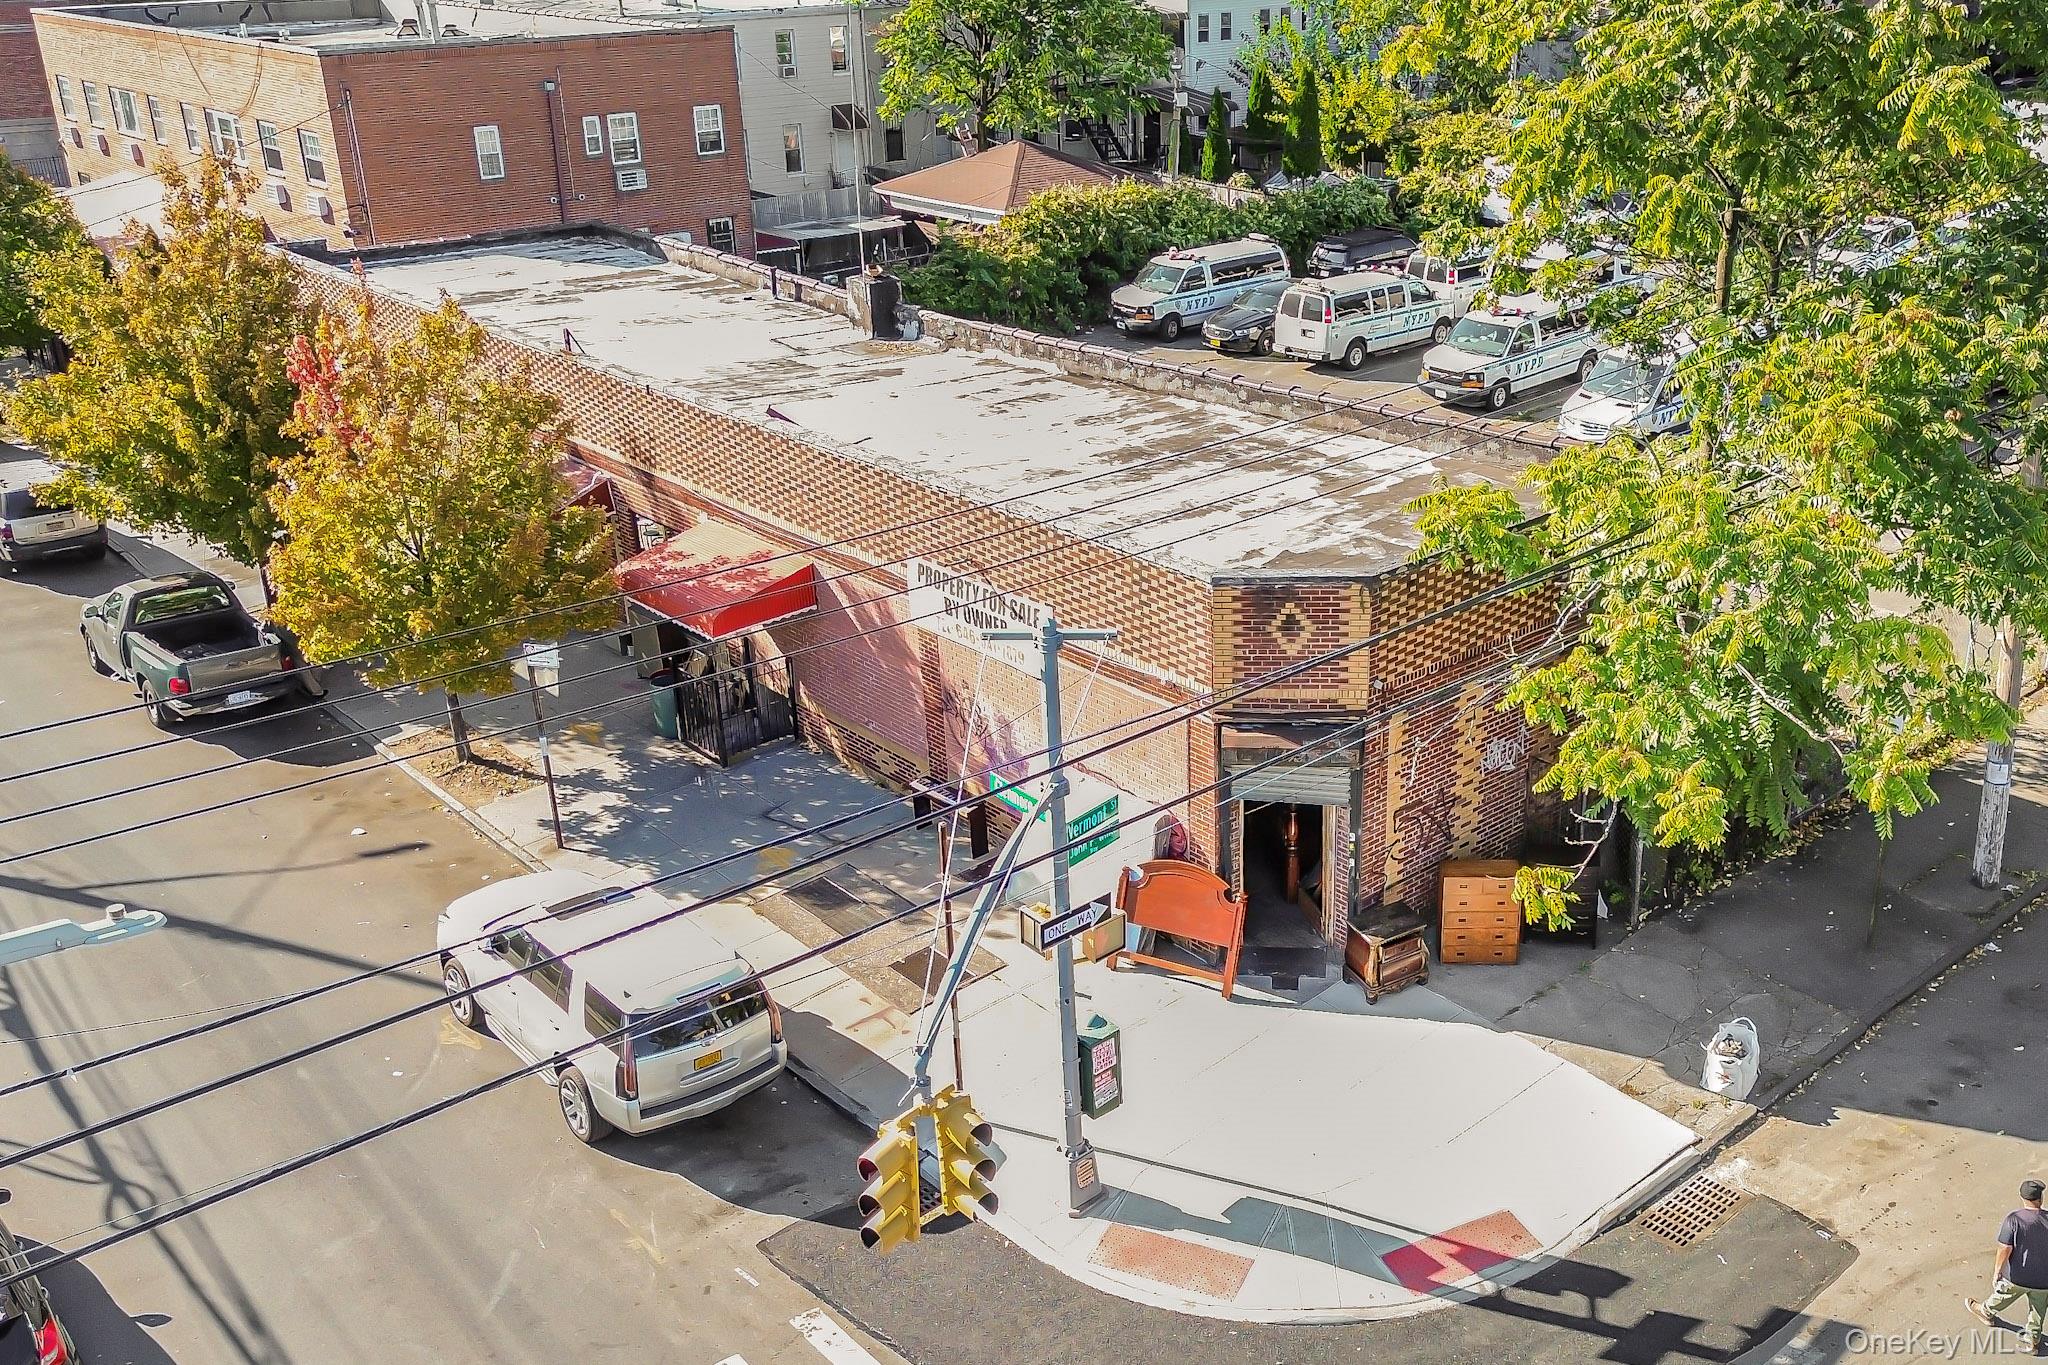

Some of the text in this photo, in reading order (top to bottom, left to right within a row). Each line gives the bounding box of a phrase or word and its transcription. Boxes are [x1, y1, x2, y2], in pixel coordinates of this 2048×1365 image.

[1185, 296, 1216, 312] NYPD
[1402, 311, 1430, 328] NYPD
[1514, 356, 1545, 375] NYPD
[917, 562, 1041, 629] PROPERTY FOR SALE
[944, 596, 1008, 630] BY OWNER
[1067, 804, 1107, 840] Vermont
[1047, 906, 1098, 939] ONE WAY
